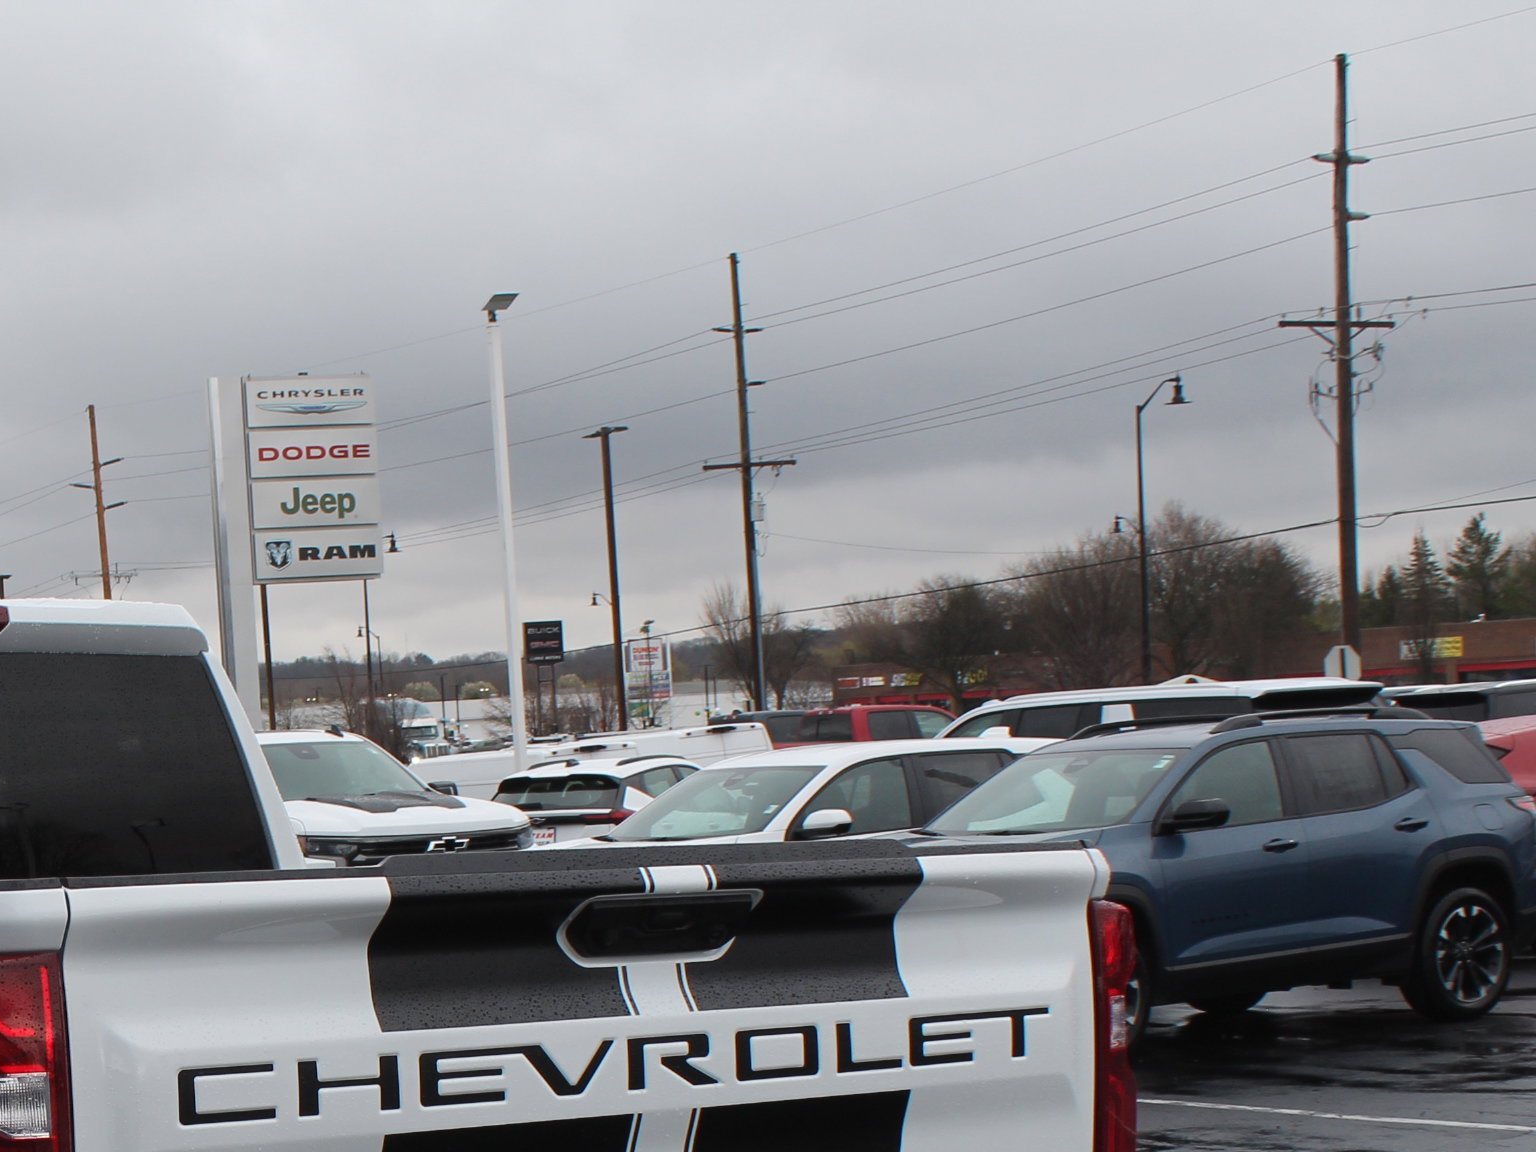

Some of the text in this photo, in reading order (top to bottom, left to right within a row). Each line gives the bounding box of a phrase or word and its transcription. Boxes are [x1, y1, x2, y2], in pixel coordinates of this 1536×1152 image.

[257, 388, 365, 399] CHRYSLER
[258, 444, 371, 462] DODGE
[280, 487, 356, 519] Jeep
[298, 544, 376, 561] RAM
[527, 626, 561, 635] BUICK
[178, 1008, 1050, 1126] CHEVROLET
